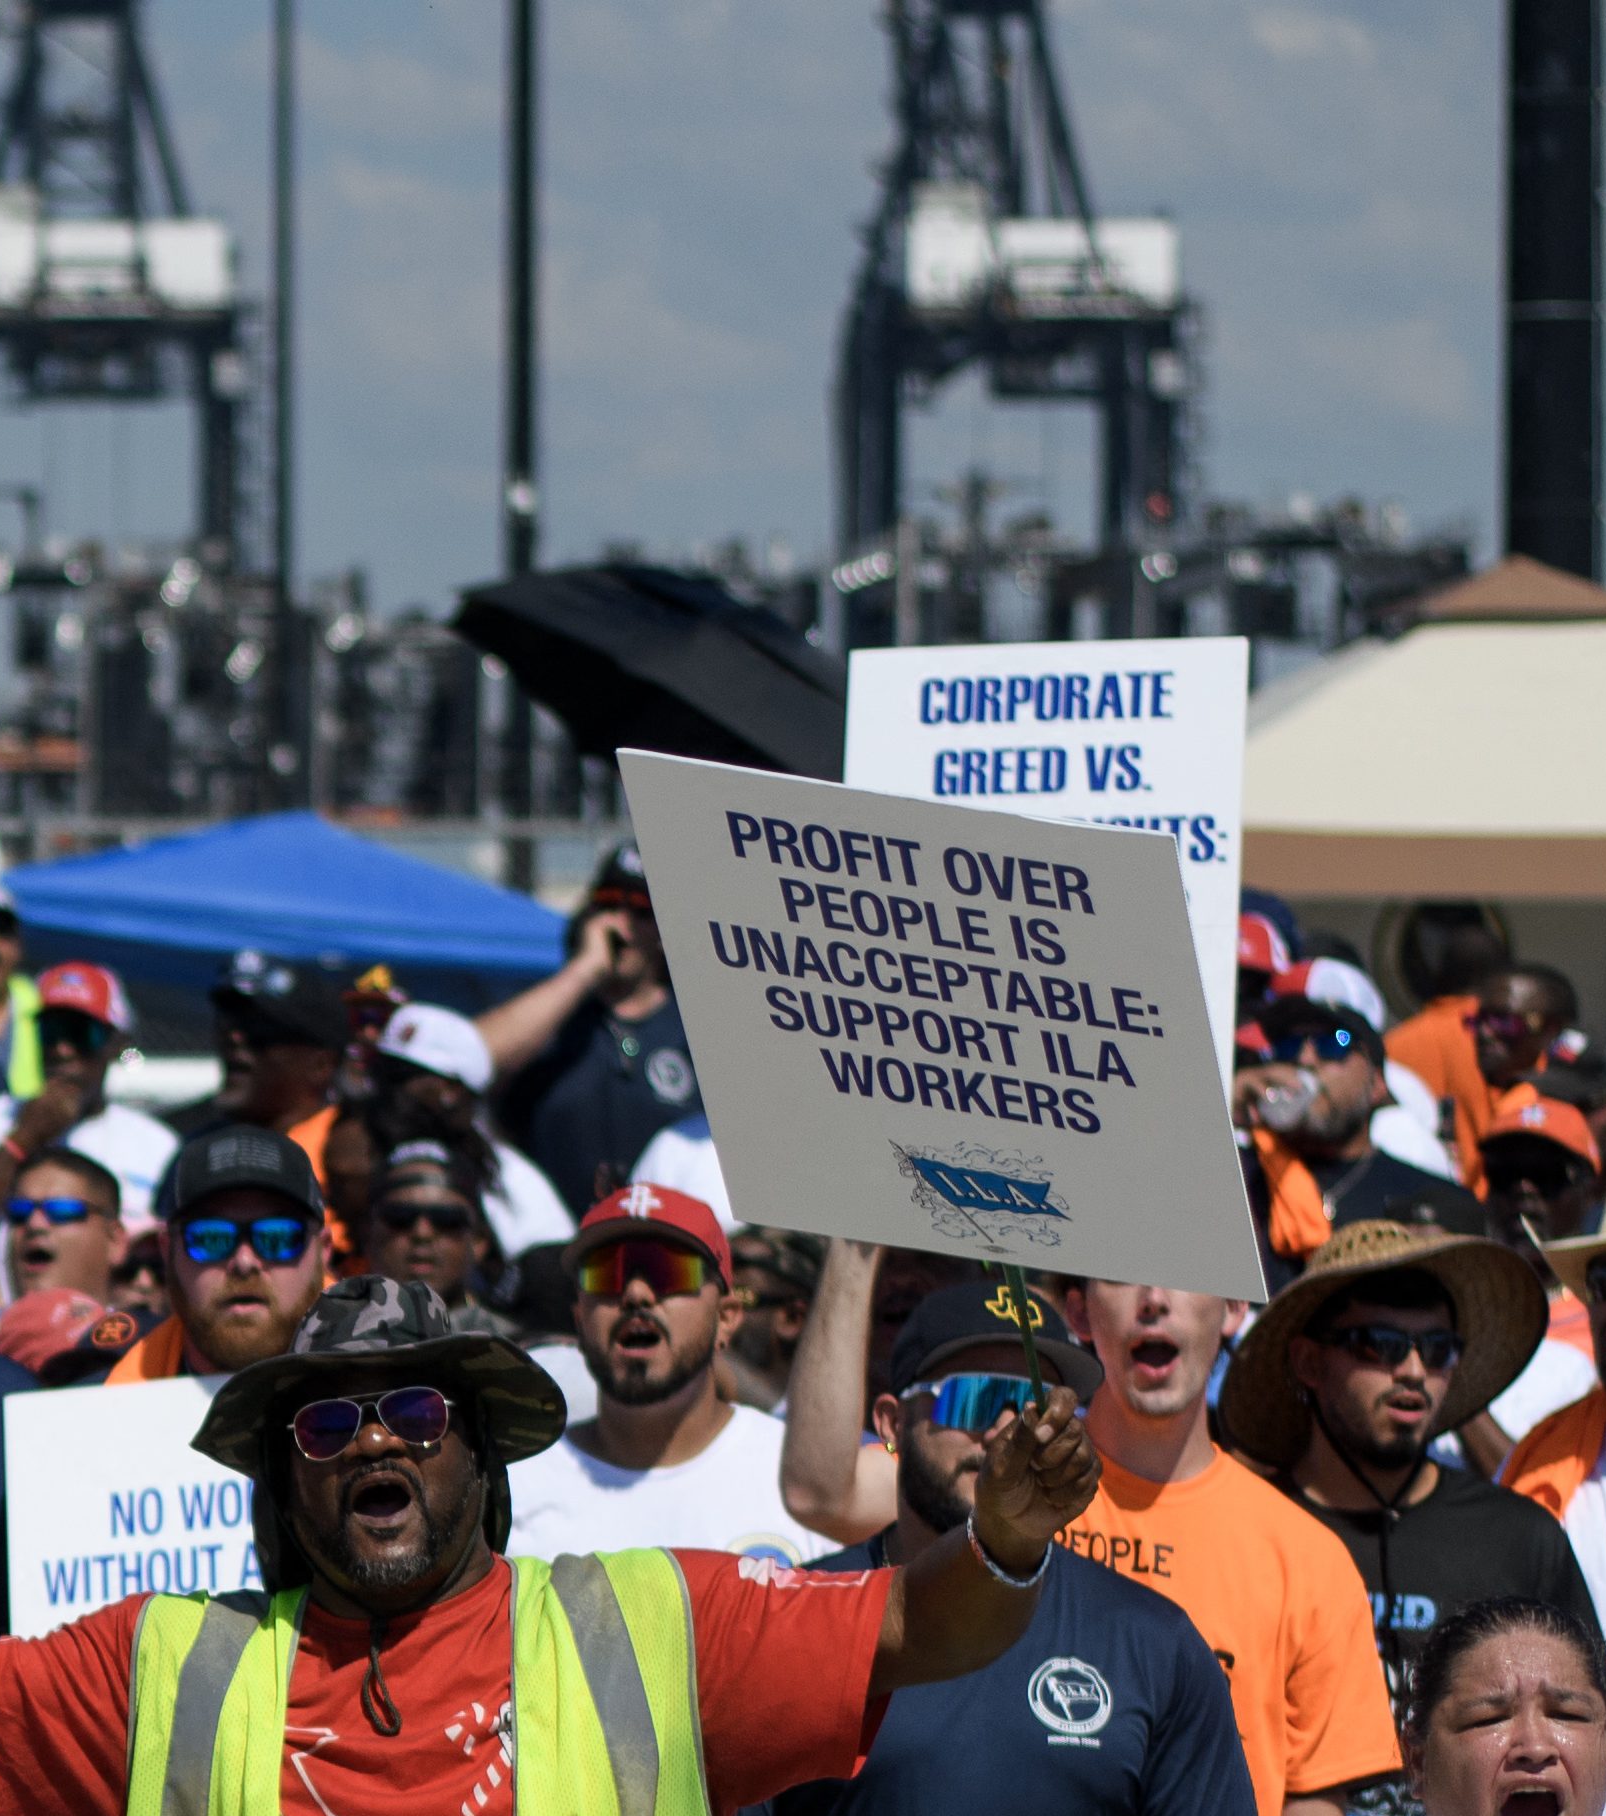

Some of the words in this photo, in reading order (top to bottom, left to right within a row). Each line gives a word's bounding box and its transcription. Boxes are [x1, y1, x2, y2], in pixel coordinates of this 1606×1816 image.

[919, 671, 1176, 727] CORPORATE
[932, 744, 1068, 796] GREED
[1085, 744, 1154, 792] VS.
[725, 810, 922, 888] PROFIT
[942, 846, 1096, 915] OVER
[783, 877, 996, 957] PEOPLE
[1010, 915, 1067, 966] IS
[708, 920, 1165, 1038] UNACCEPTABLE:
[768, 986, 1019, 1068] SUPPORT
[1041, 1030, 1137, 1089] ILA
[820, 1048, 1102, 1135] WORKERS
[939, 1168, 1050, 1212] I.L.A.
[110, 1487, 163, 1538] NO
[178, 1479, 255, 1531] WO
[42, 1544, 223, 1606] WITHOUT
[240, 1541, 263, 1588] A
